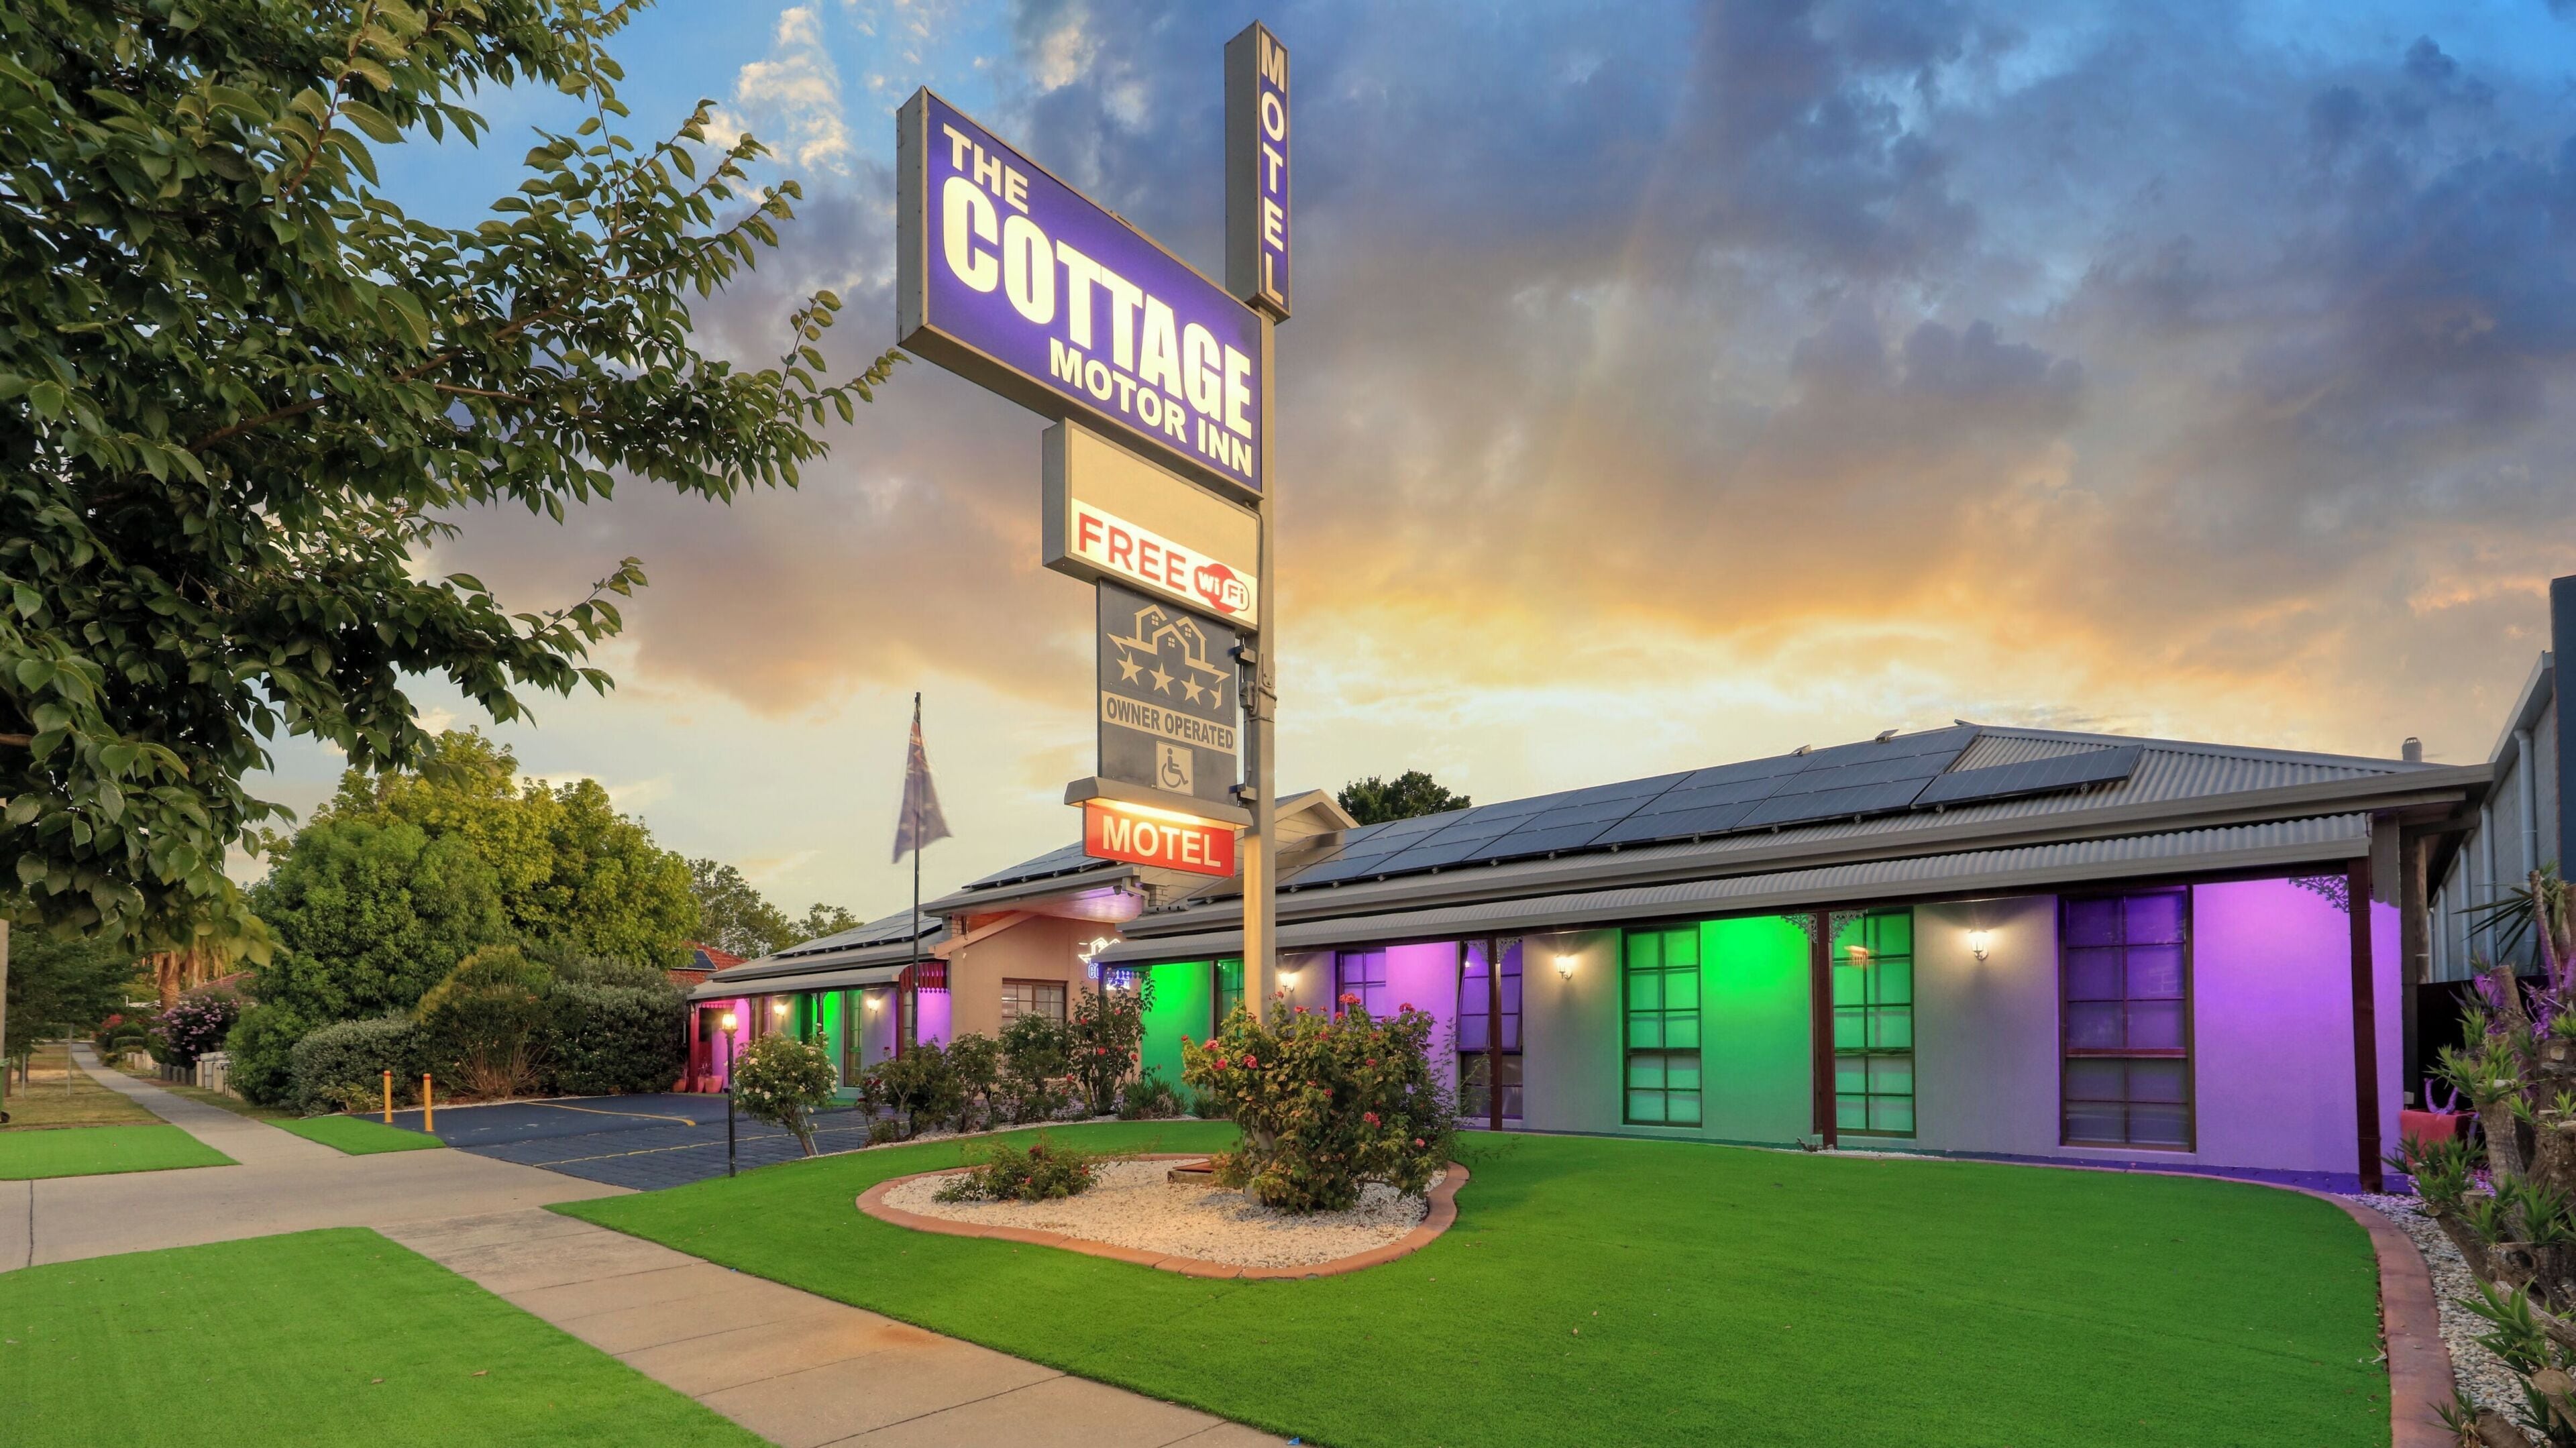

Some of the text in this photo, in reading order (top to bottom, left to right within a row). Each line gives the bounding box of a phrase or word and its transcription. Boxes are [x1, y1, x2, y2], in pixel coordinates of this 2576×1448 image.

[943, 123, 1028, 214] THE
[1261, 31, 1284, 305] MOTEL
[943, 176, 1252, 439] COTTAGE
[1050, 337, 1252, 478] MOTOR INN
[1079, 512, 1186, 592] FREE
[1107, 697, 1234, 749] OWNER OPERATED
[1103, 816, 1221, 867] MOTEL
